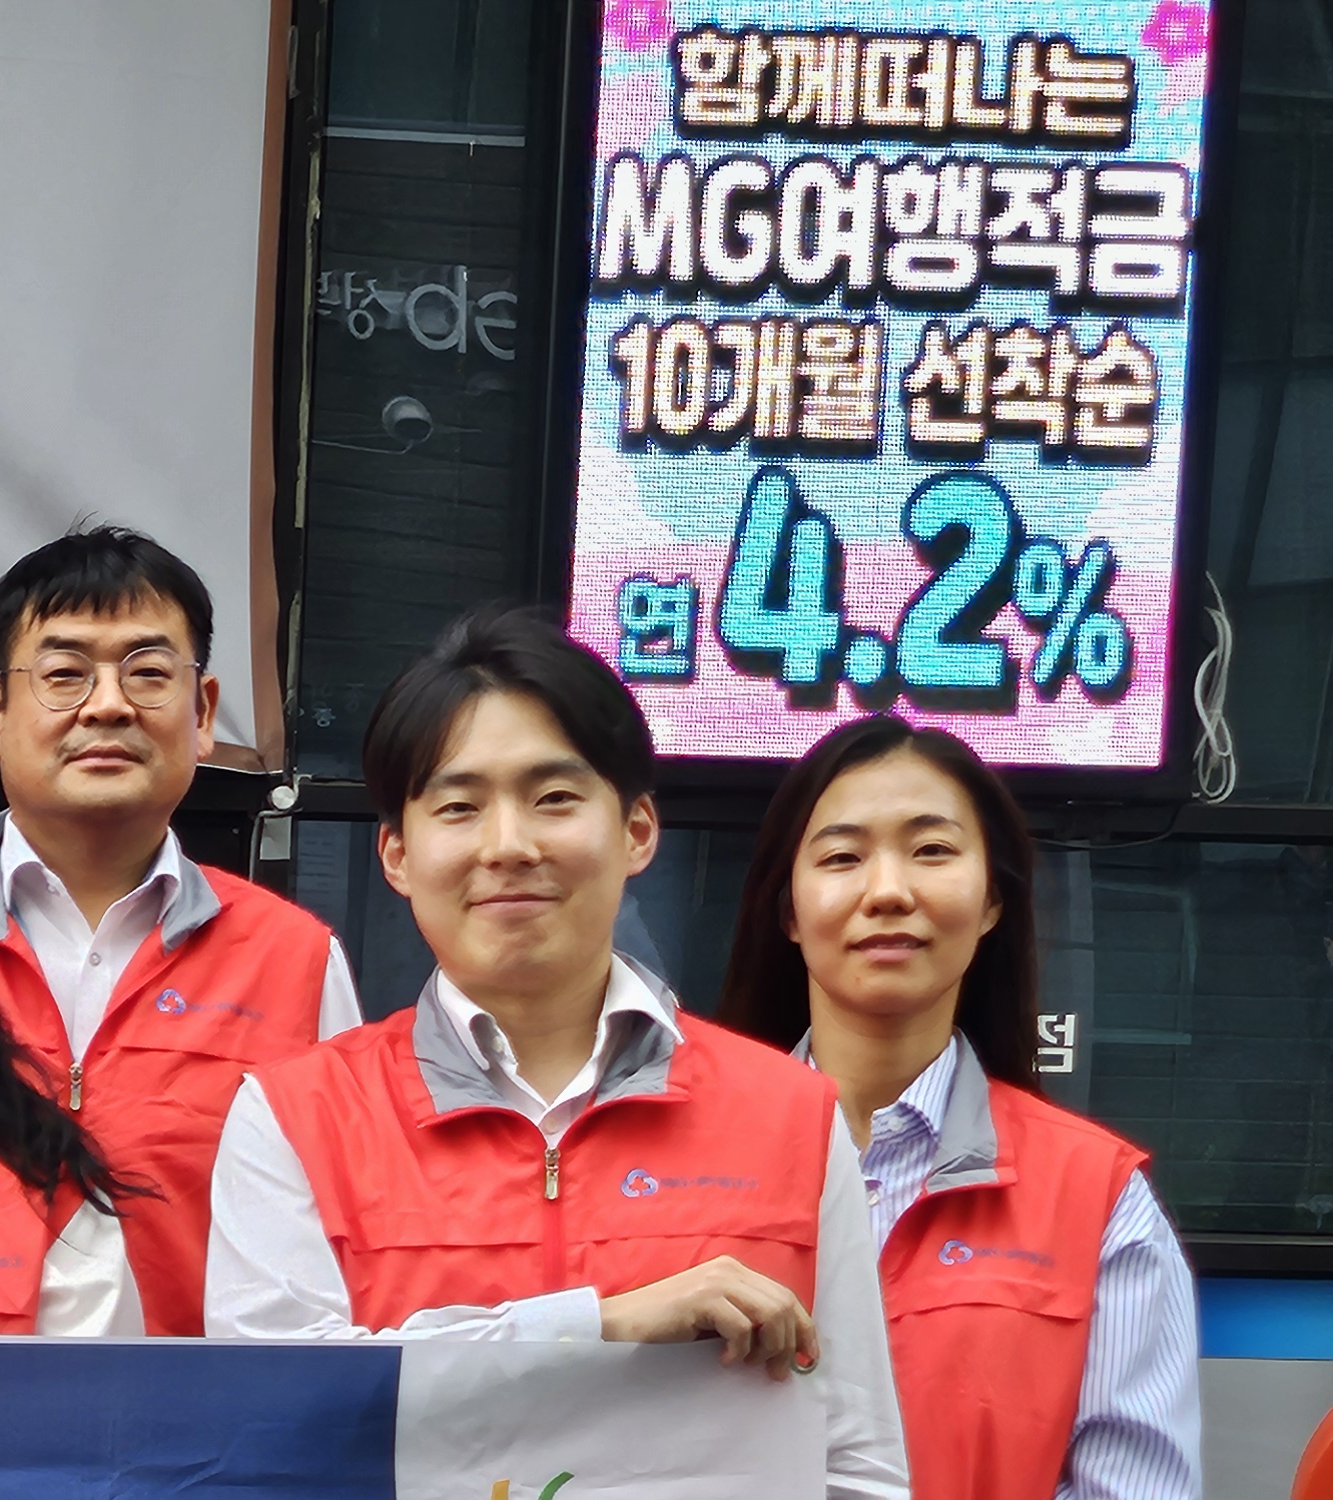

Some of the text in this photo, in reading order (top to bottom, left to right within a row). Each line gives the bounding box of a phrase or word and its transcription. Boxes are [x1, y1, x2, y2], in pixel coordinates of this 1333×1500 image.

[599, 158, 1187, 298] MG여행적금
[613, 320, 1156, 447] 10개월 선착순
[720, 472, 1128, 687] 4.2%
